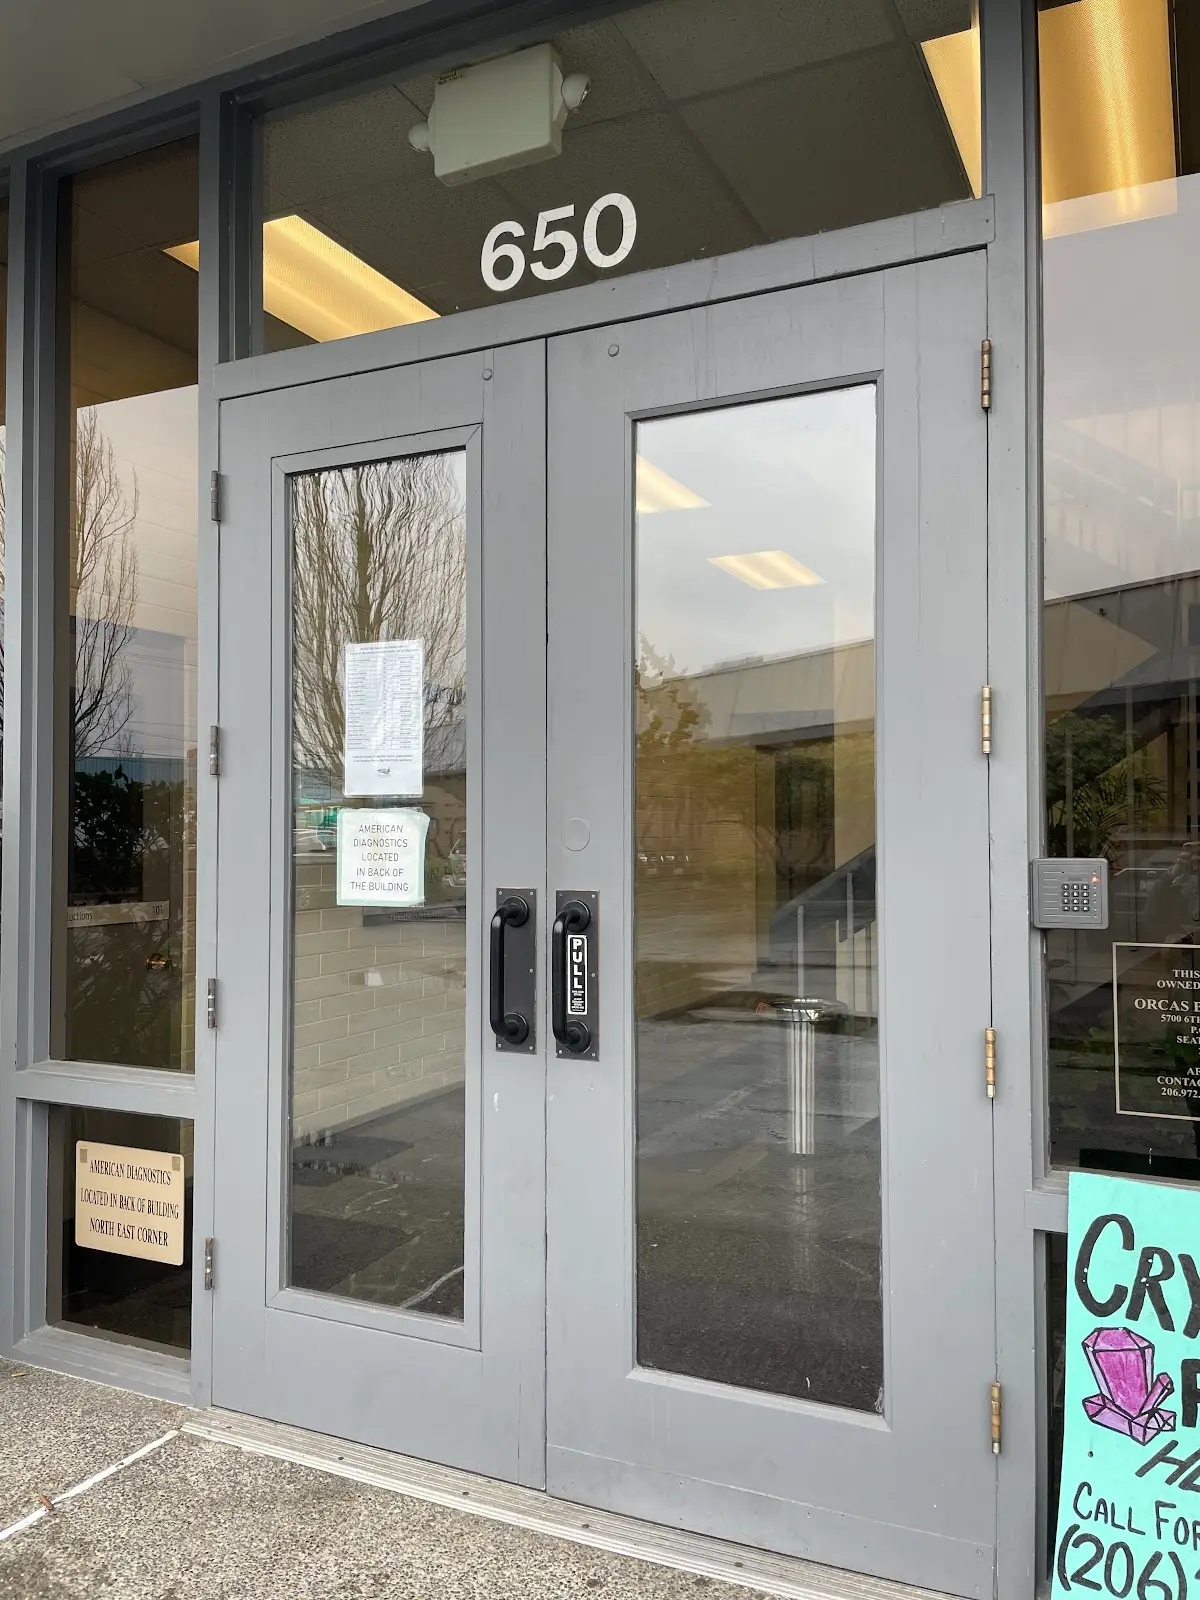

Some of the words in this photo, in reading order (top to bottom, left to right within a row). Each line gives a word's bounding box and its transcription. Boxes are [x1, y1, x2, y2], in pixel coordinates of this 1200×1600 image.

[480, 192, 637, 292] 650
[359, 824, 404, 834] AMERICAN
[353, 838, 408, 848] DIAGNOSTICS
[362, 852, 399, 862] LOCATED
[356, 867, 366, 877] IN
[367, 867, 391, 877] BACK
[392, 868, 404, 877] OF
[350, 881, 366, 891] THE
[368, 881, 409, 892] BUILDING
[572, 938, 583, 989] PULL
[1172, 969, 1200, 978] THIS
[1156, 979, 1200, 990] OWNED
[1134, 998, 1190, 1012] ORCAS
[1160, 1014, 1182, 1023] 5700
[89, 1159, 125, 1178] AMERICAN
[126, 1164, 171, 1186] DIAGNOSTICS
[80, 1187, 109, 1206] LOCATED
[110, 1192, 117, 1208] IN
[119, 1194, 135, 1212] BACK
[136, 1197, 146, 1213] OF
[147, 1199, 179, 1219] BUILDING
[89, 1217, 114, 1236] NORTH
[117, 1222, 135, 1240] EAST
[137, 1226, 168, 1247] CORNER
[1072, 1481, 1146, 1536] CALL
[1057, 1523, 1188, 1600] (206)
